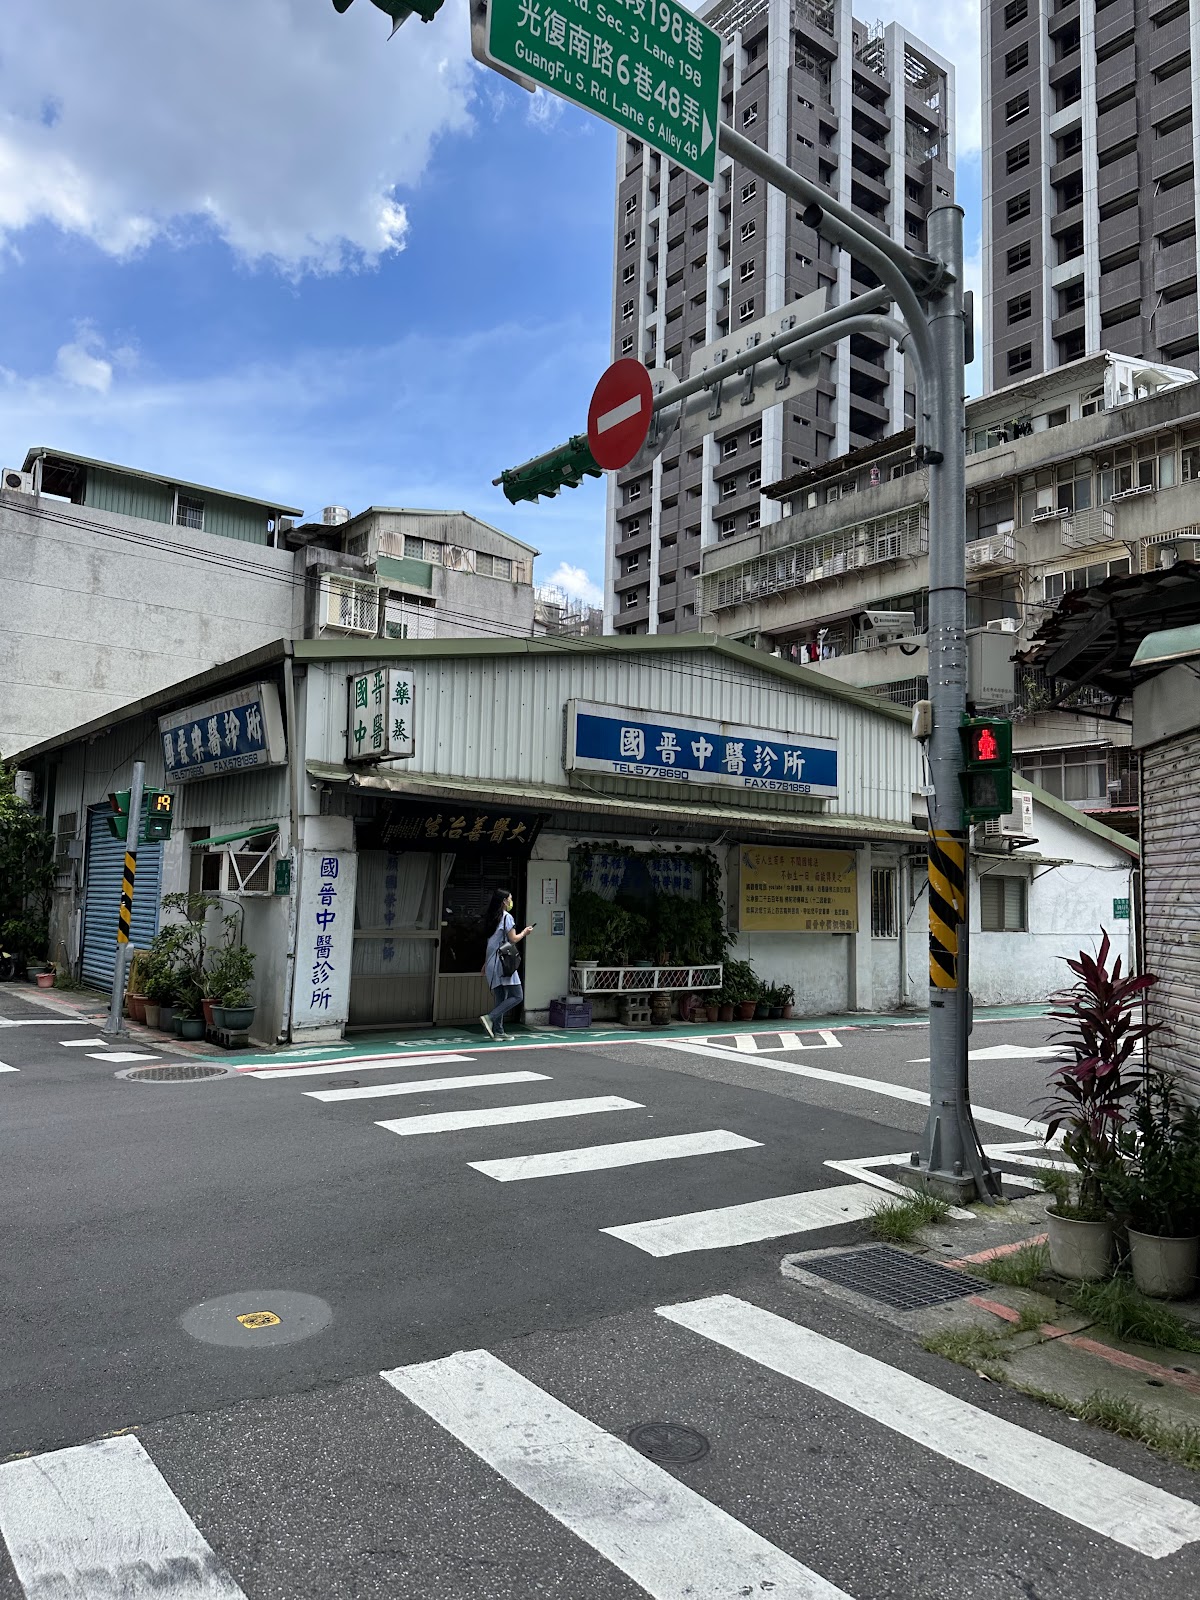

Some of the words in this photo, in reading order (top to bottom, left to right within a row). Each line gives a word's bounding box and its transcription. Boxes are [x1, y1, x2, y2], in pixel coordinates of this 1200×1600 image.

[516, 0, 701, 133] 光復南路6巷48弄
[596, 3, 626, 36] Sec.
[629, 24, 640, 44] 3
[643, 33, 675, 69] Lane
[678, 59, 702, 88] 198
[514, 40, 572, 85] GuangFu
[575, 75, 587, 92] S.
[590, 85, 609, 106] Rd.
[612, 93, 644, 126] Lane
[647, 117, 655, 133] 6
[657, 123, 682, 154] Alley
[683, 140, 698, 161] 48
[612, 762, 689, 780] TEL:5778690
[619, 726, 806, 781] 國晉中醫診所
[309, 856, 340, 1011] 國晉中醫診所
